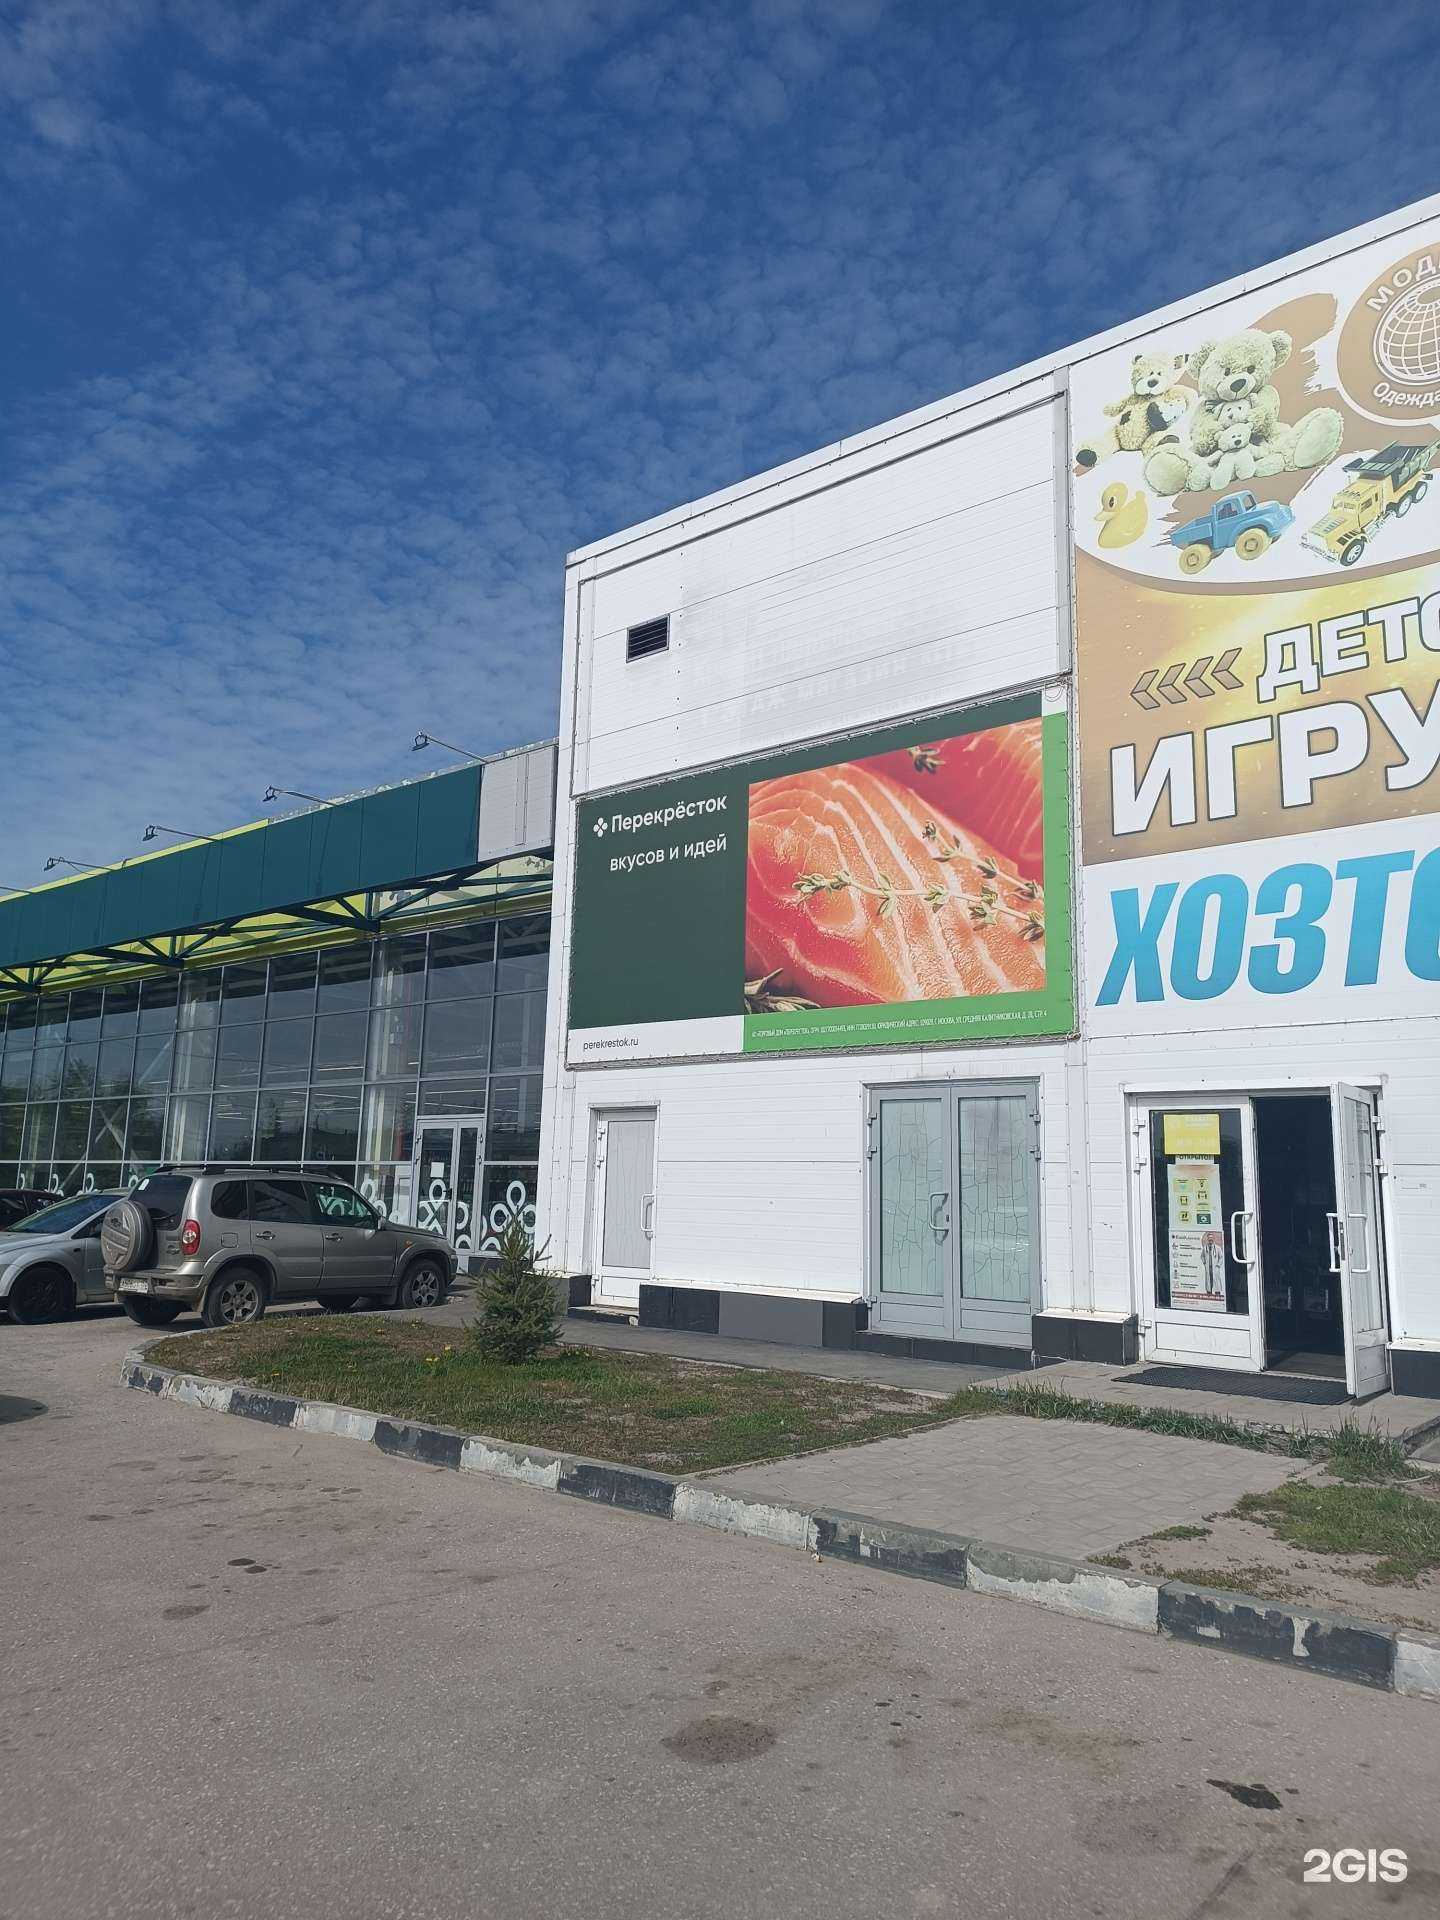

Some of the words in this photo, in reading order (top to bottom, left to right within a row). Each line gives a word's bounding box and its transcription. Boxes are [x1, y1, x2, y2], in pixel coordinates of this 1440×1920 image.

[1366, 255, 1440, 312] МОД
[1110, 678, 1440, 837] ИГРУ
[611, 795, 728, 833] Перекрёсток
[609, 848, 665, 873] вкусов
[669, 845, 679, 861] и
[684, 833, 728, 859] идей
[583, 1036, 639, 1051] perekrestok.ru
